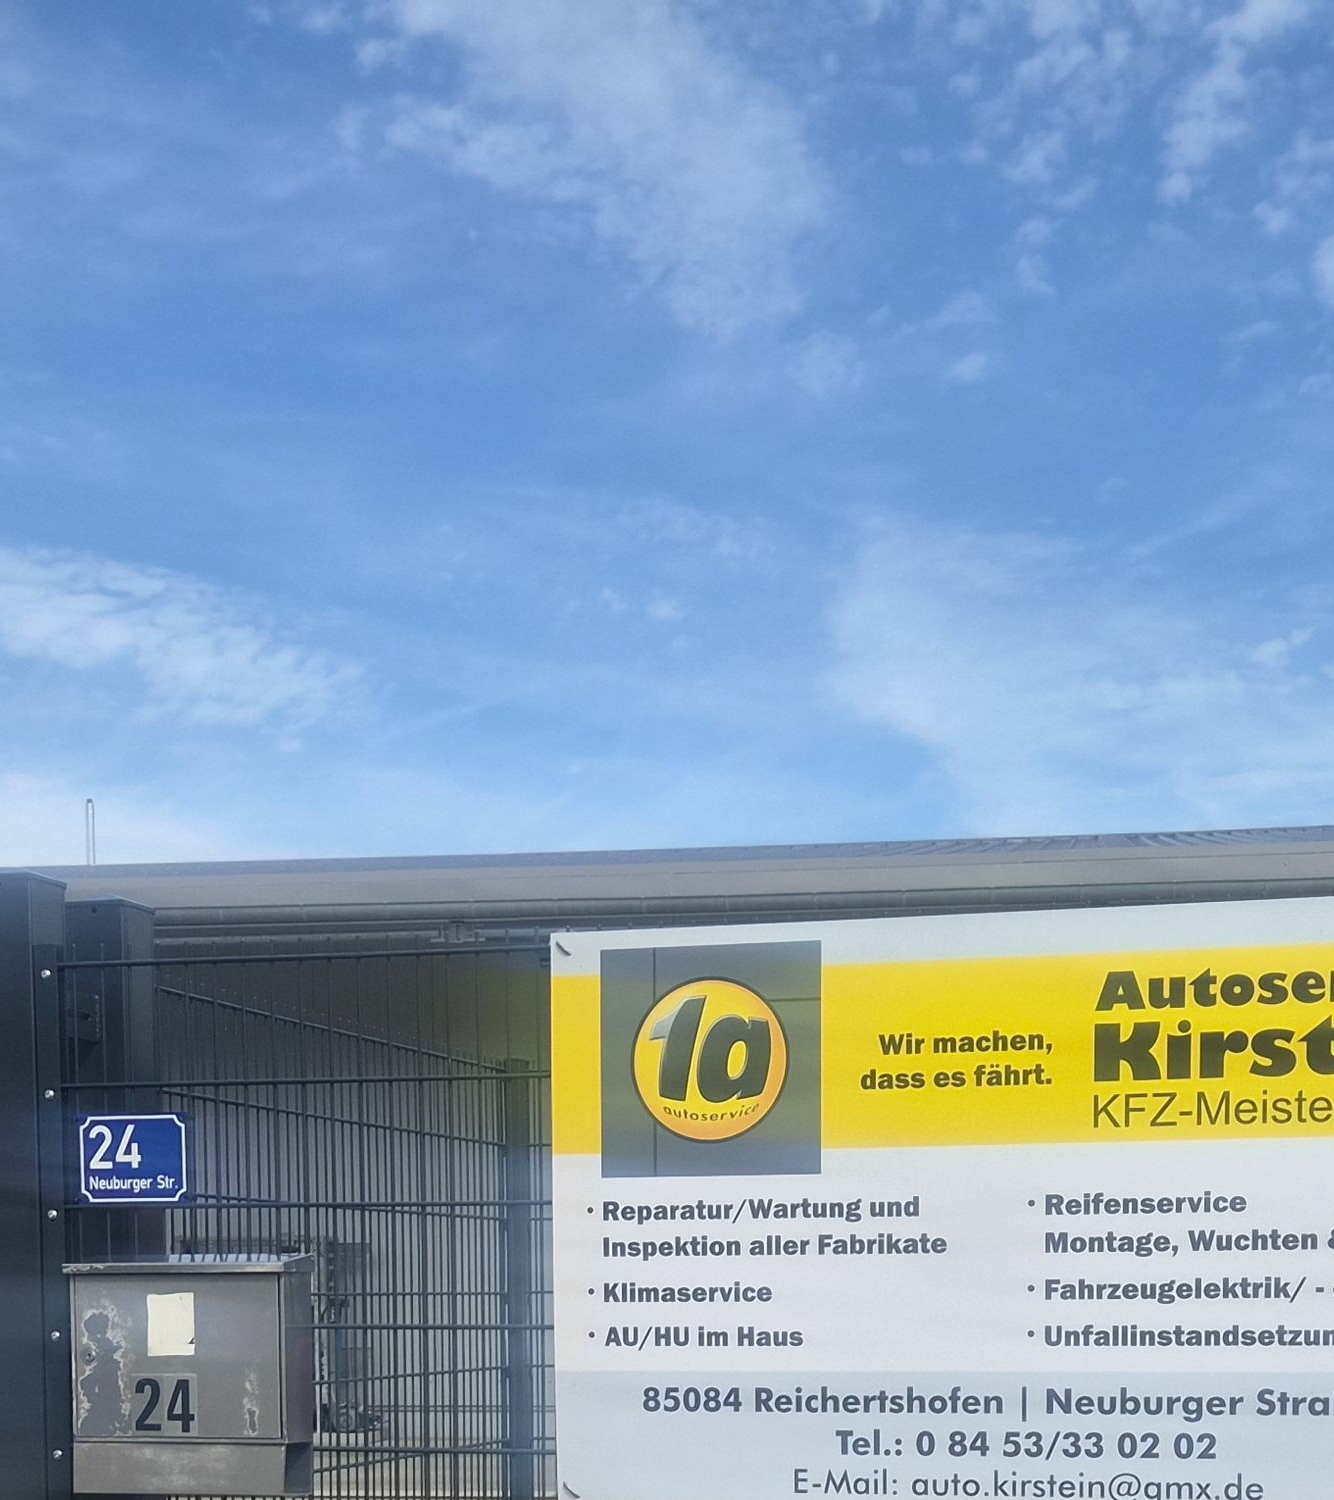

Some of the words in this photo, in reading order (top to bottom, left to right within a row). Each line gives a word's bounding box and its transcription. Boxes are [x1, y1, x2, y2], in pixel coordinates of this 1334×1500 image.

[649, 995, 772, 1103] 1a
[879, 1033, 925, 1055] Wir
[933, 1030, 1053, 1055] machen,
[861, 1069, 925, 1089] dass
[934, 1071, 966, 1087] es
[974, 1064, 1052, 1086] fährt.
[663, 1104, 759, 1121] autoservice
[89, 1125, 142, 1169] 24
[89, 1176, 153, 1192] Neuburger
[157, 1175, 178, 1189] Str.
[603, 1199, 862, 1224] Reparatur/Wartung
[869, 1196, 920, 1218] und
[1044, 1191, 1247, 1216] Reifenservice
[603, 1236, 741, 1261] Inspektion
[749, 1236, 810, 1256] aller
[818, 1233, 947, 1255] Fabrikate
[1044, 1232, 1178, 1256] Montage,
[1188, 1230, 1318, 1252] Wuchten
[603, 1282, 772, 1302] Klimaservice
[1044, 1277, 1306, 1304] Fahrzeugelektrik/
[605, 1326, 689, 1350] AU/HU
[698, 1326, 729, 1346] im
[737, 1327, 803, 1347] Haus
[135, 1378, 195, 1433] 24
[642, 1387, 742, 1412] 85084
[755, 1386, 1003, 1414] Reichertshofen
[1045, 1388, 1244, 1421] Neuburger
[836, 1429, 902, 1456] Tel.:
[916, 1431, 935, 1457] 0
[948, 1431, 989, 1457] 84
[1002, 1431, 1104, 1461] 53/33
[1117, 1433, 1160, 1459] 02
[1173, 1433, 1216, 1459] 02
[794, 1468, 898, 1495] E-Mail:
